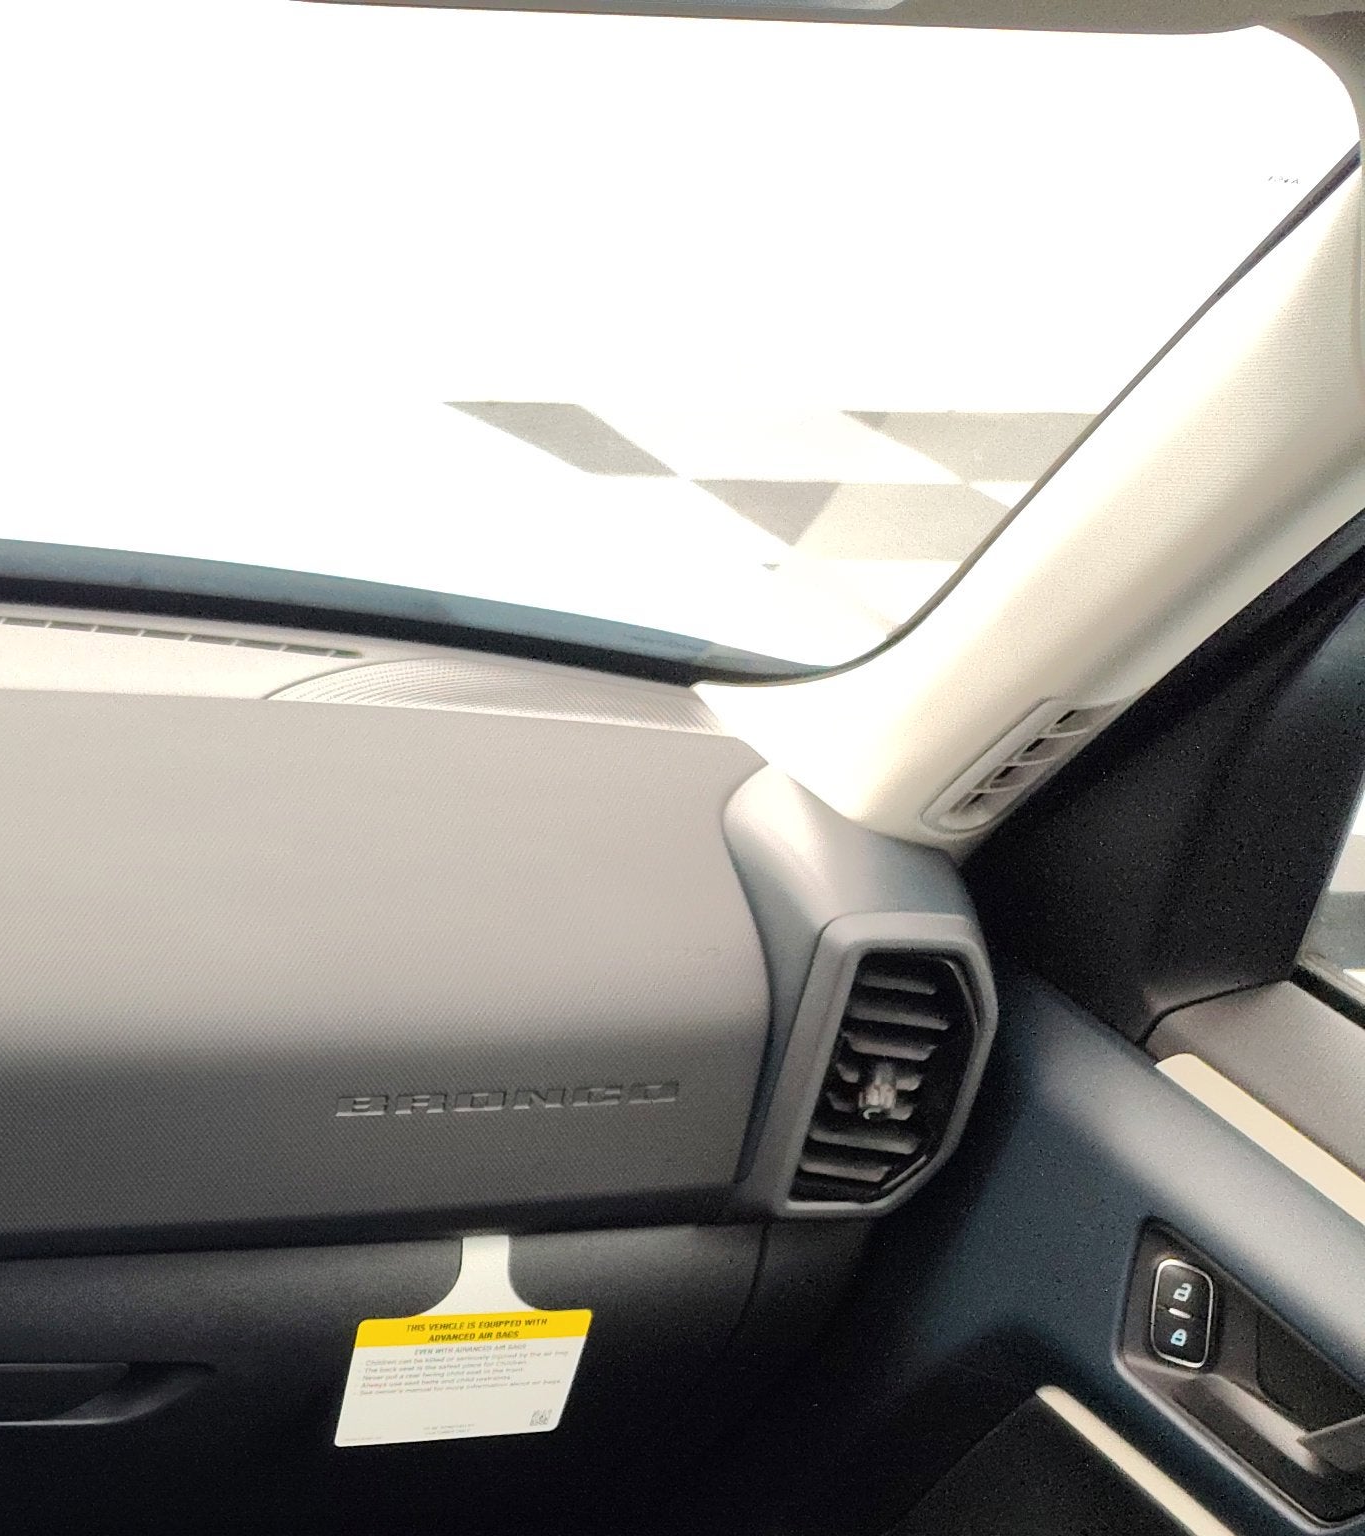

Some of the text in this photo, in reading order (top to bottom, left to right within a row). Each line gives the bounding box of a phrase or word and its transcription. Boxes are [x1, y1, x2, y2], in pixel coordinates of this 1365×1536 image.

[335, 1080, 680, 1117] BRONCO
[406, 1324, 425, 1332] THIS
[429, 1322, 465, 1331] VEHICLE
[478, 1320, 521, 1329] EQUIPPED
[524, 1318, 548, 1327] WITH
[428, 1331, 519, 1342] ADVANCED AIR BAGS
